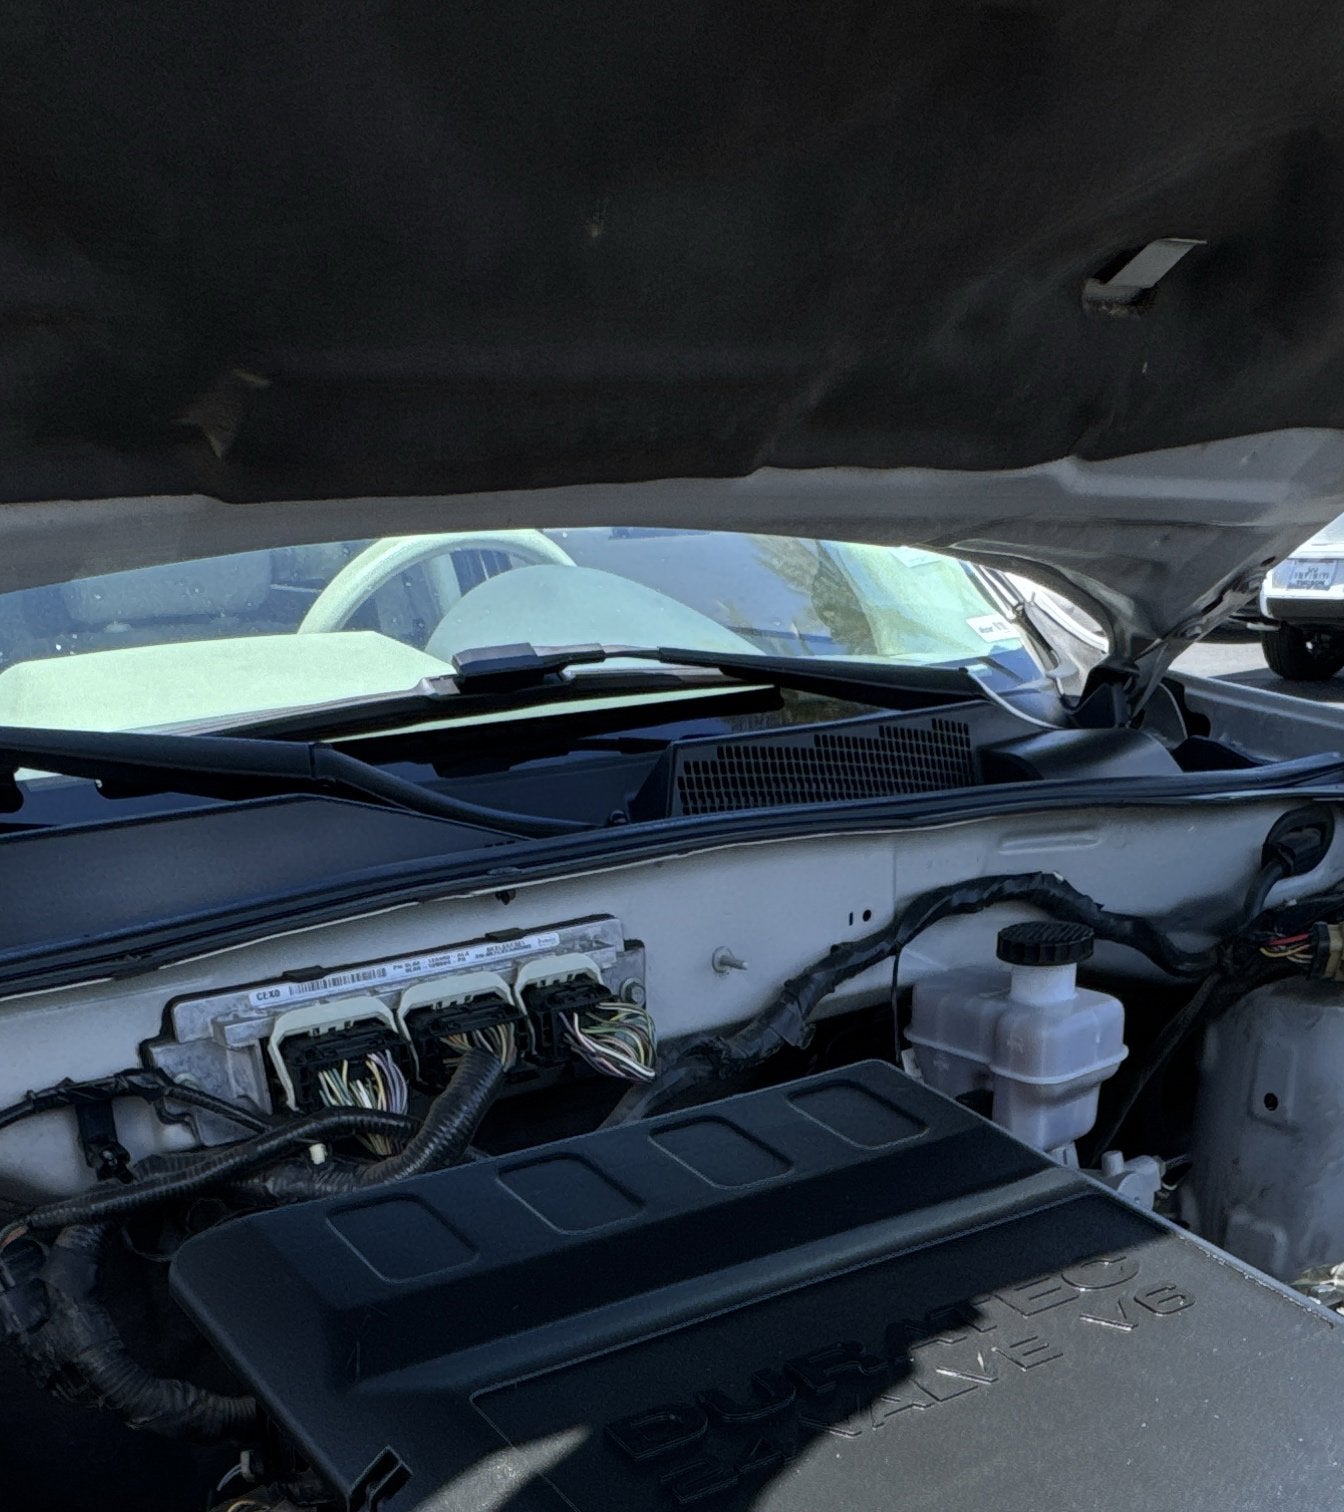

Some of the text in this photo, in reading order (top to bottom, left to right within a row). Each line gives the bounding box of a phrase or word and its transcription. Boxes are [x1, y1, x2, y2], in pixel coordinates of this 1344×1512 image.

[604, 1255, 1141, 1460] DURATEC
[798, 1334, 1065, 1438] VALVE
[1079, 1284, 1197, 1332] V6
